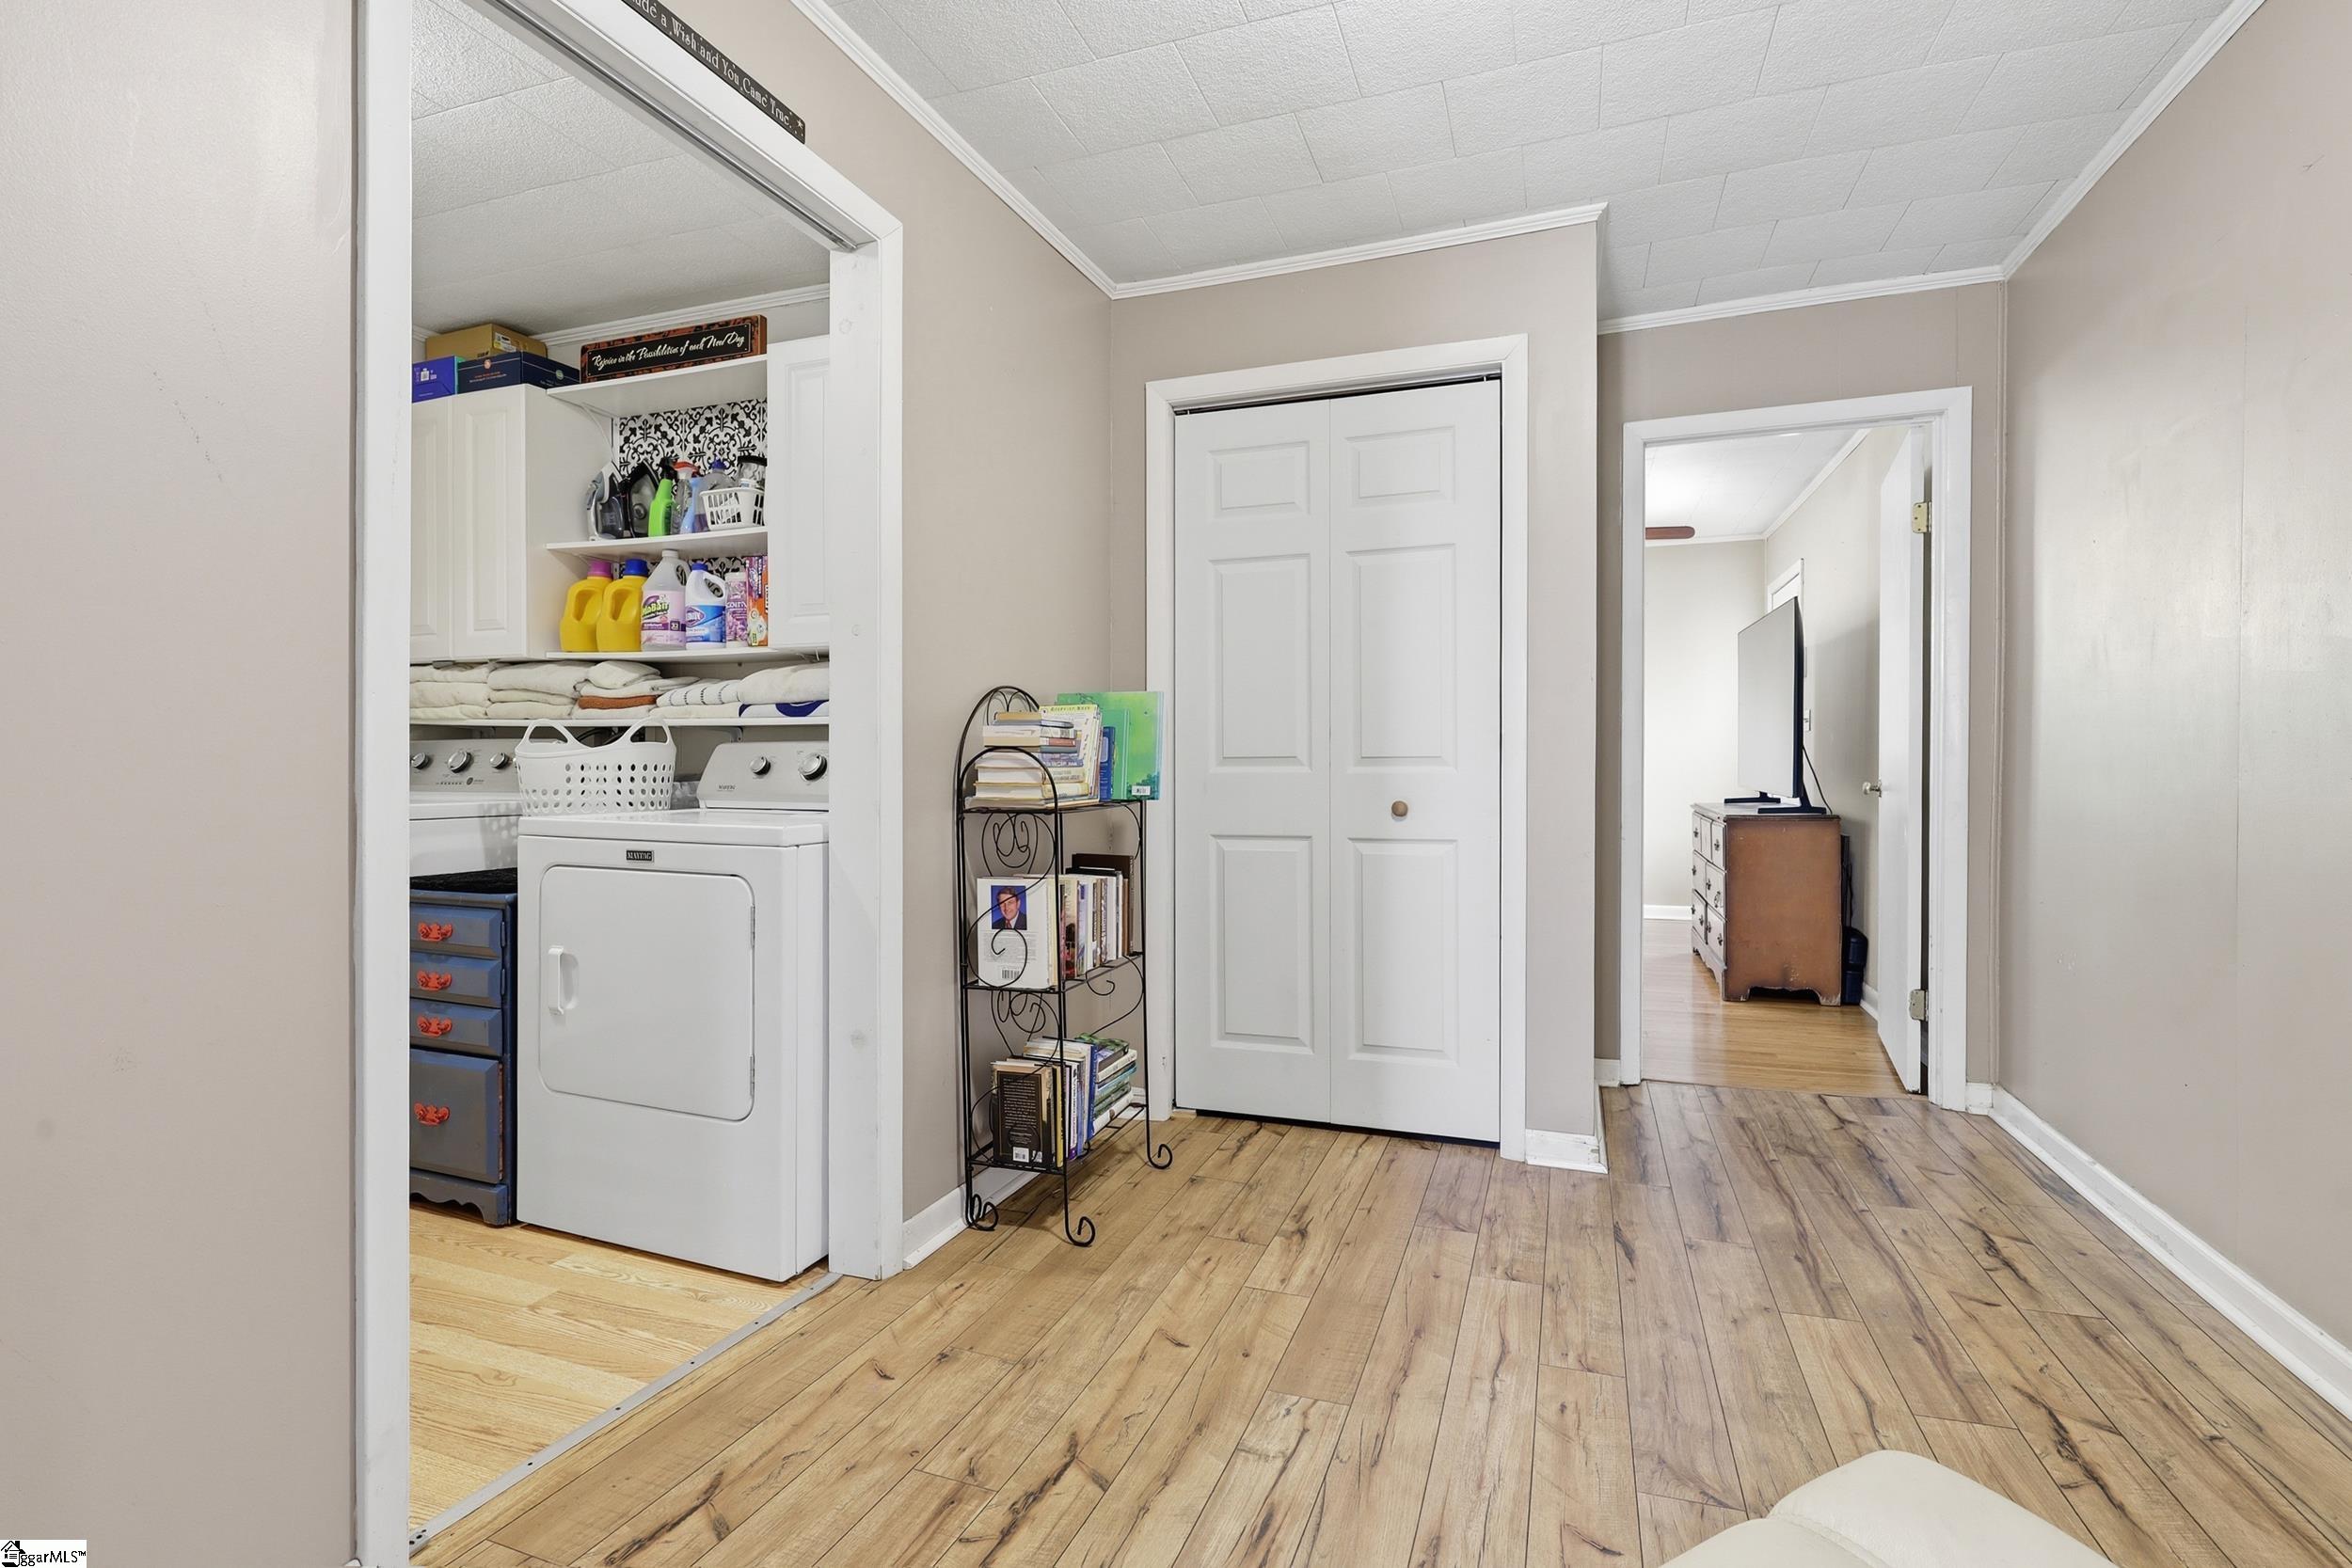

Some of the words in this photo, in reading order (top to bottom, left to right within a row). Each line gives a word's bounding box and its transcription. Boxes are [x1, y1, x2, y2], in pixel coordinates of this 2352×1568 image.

[660, 13, 667, 27] a
[672, 17, 696, 51] Wish
[700, 46, 719, 69] and
[722, 58, 739, 86] You
[743, 77, 768, 108] Came
